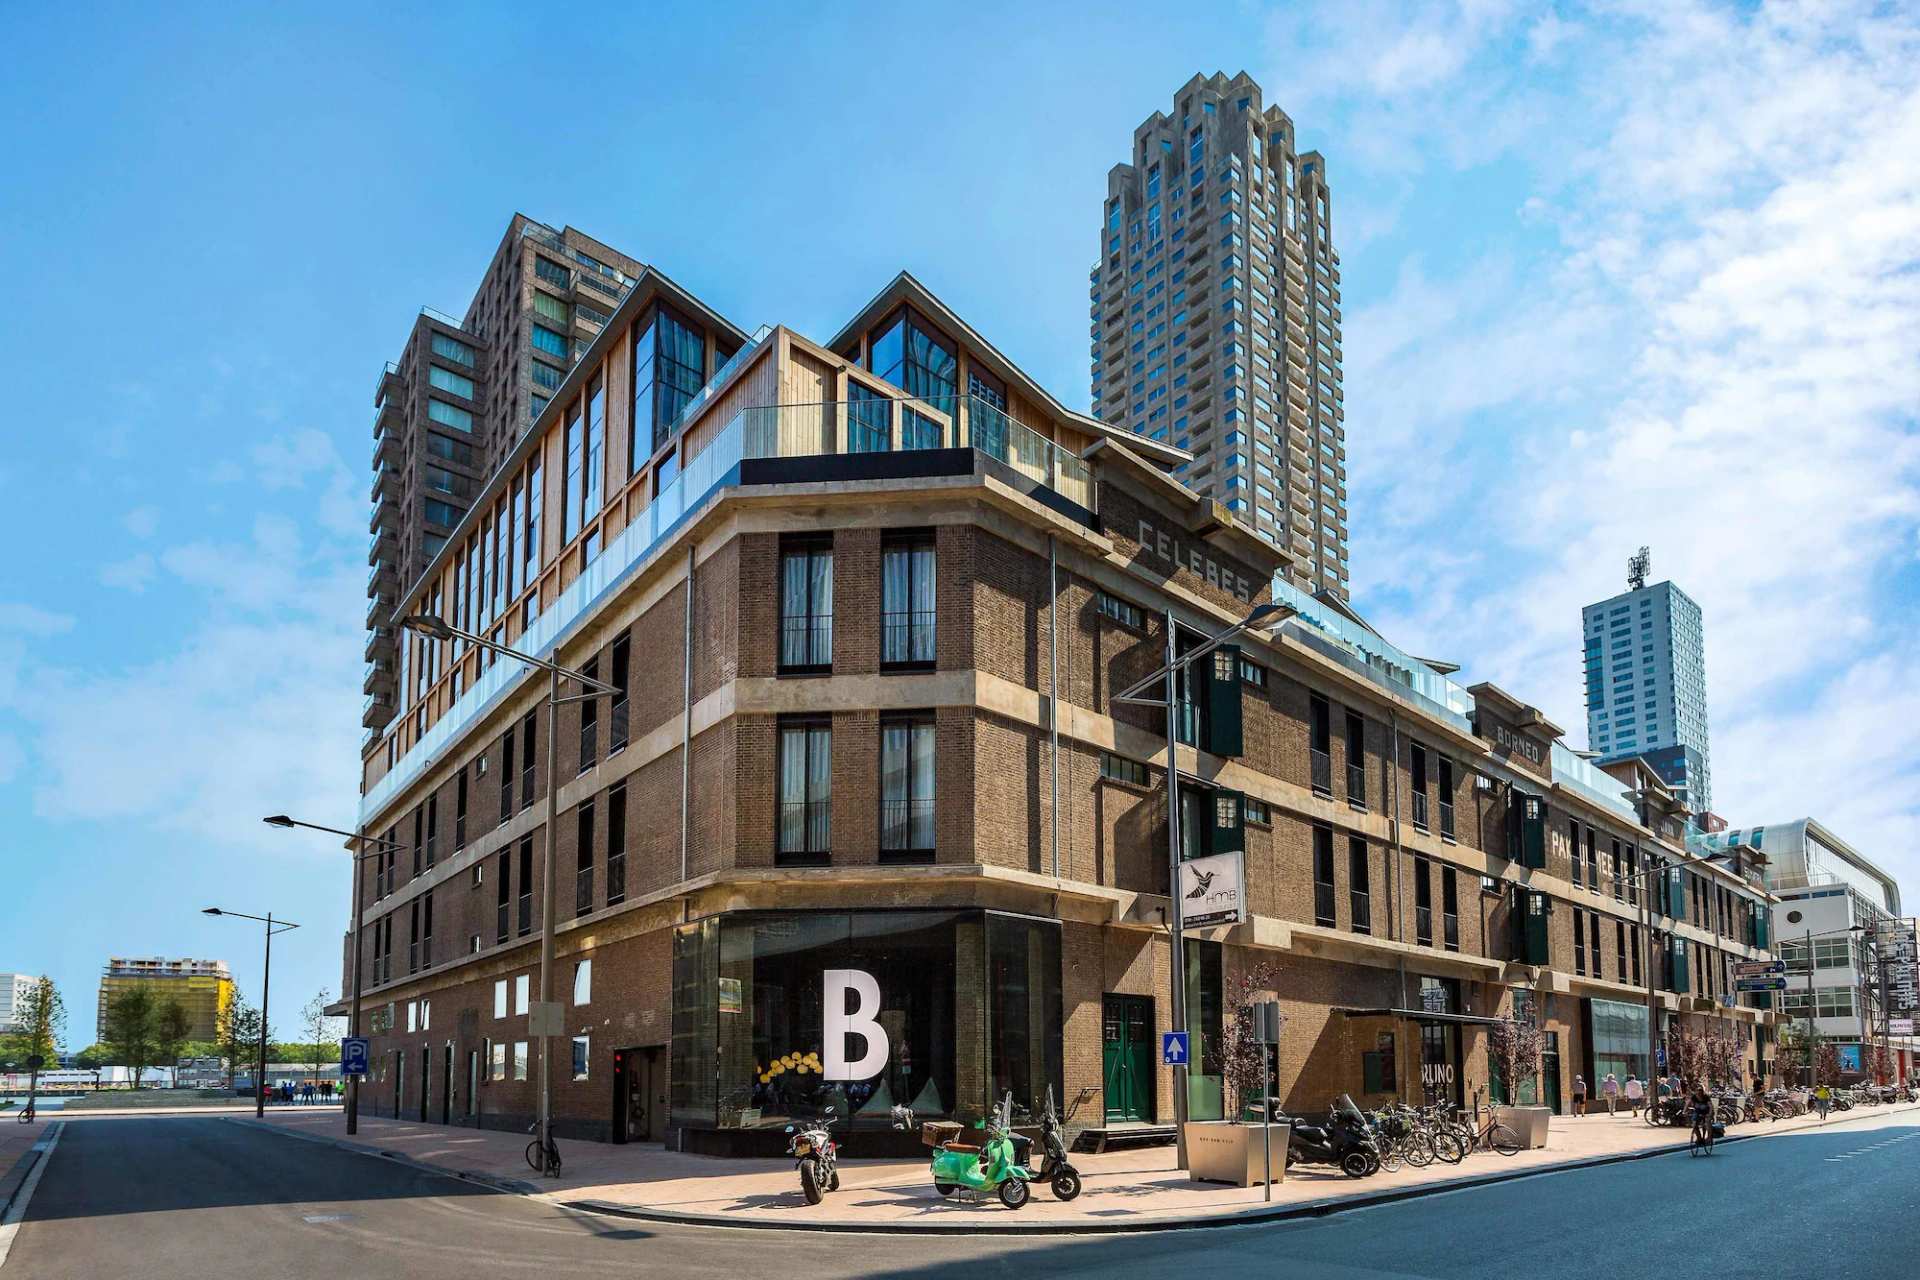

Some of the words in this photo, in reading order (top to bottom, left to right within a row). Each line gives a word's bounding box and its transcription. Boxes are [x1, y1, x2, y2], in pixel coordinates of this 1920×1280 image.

[1138, 519, 1249, 604] CELEBES
[1497, 726, 1538, 763] BORNEO
[349, 1045, 362, 1060] P
[823, 969, 889, 1081] B
